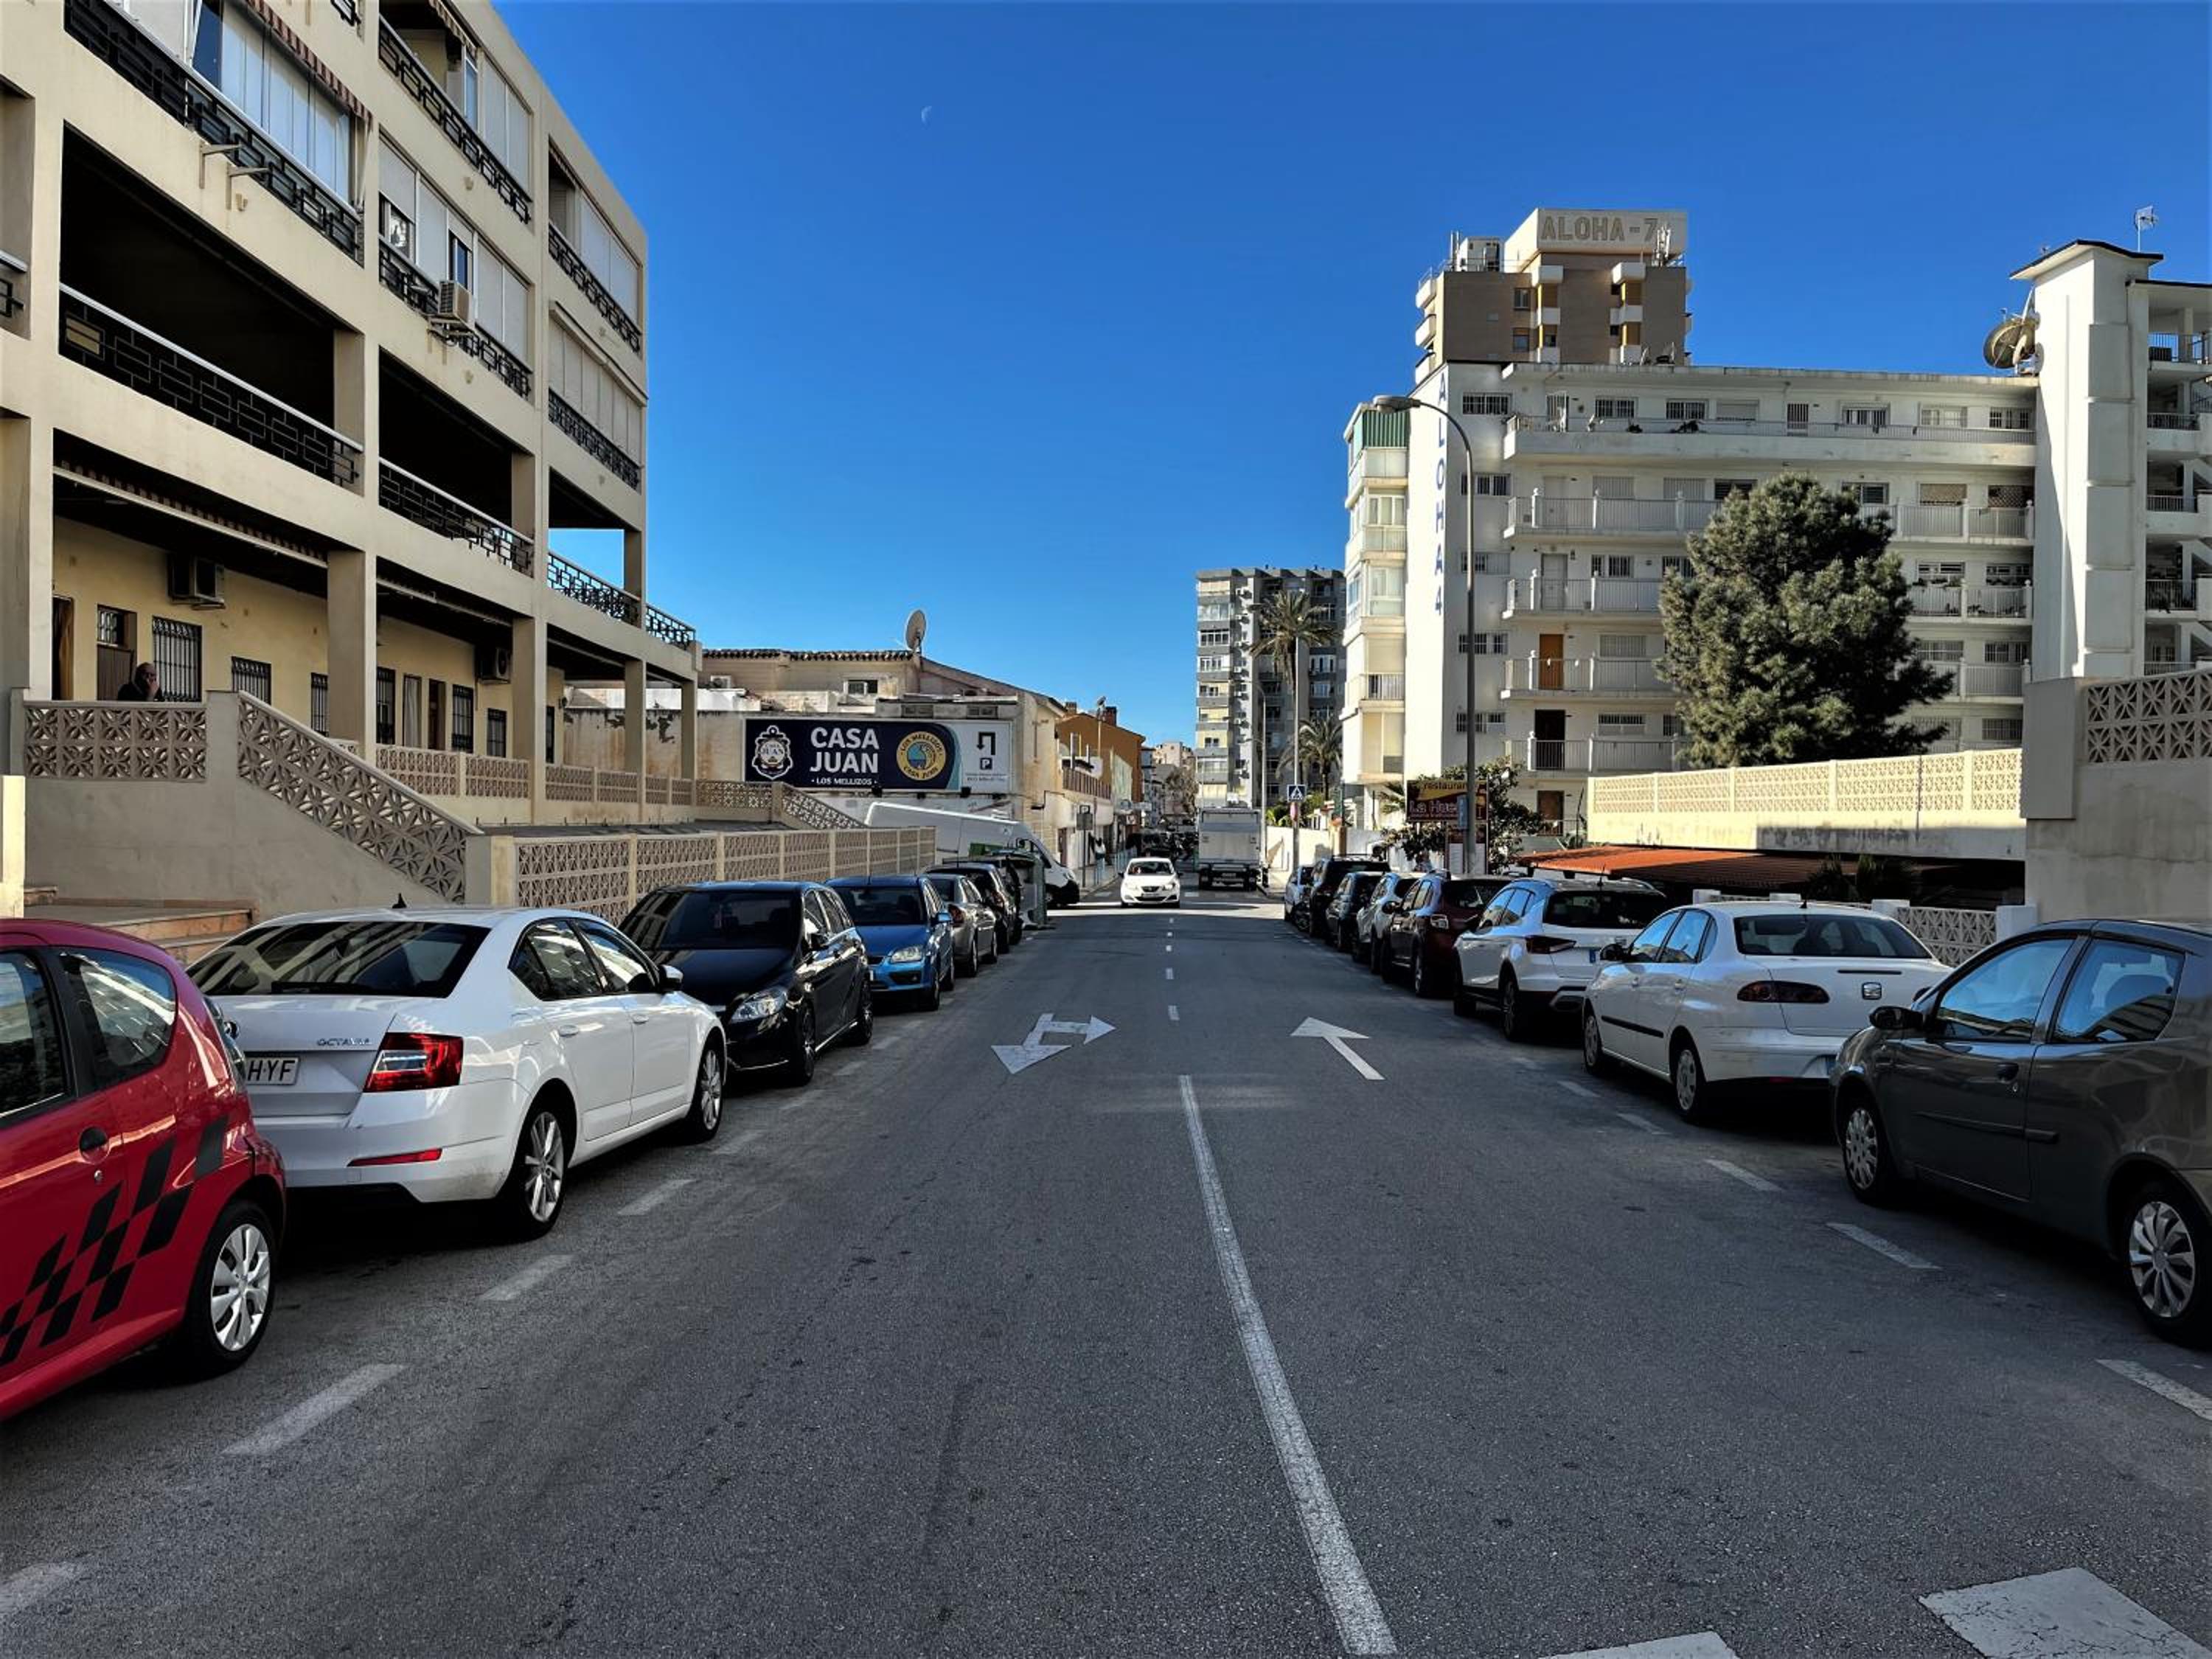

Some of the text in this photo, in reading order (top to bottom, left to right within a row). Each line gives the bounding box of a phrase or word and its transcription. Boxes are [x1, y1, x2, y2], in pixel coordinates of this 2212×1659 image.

[810, 727, 880, 749] CASA
[810, 751, 878, 773] JUAN
[816, 777, 832, 785] LOS
